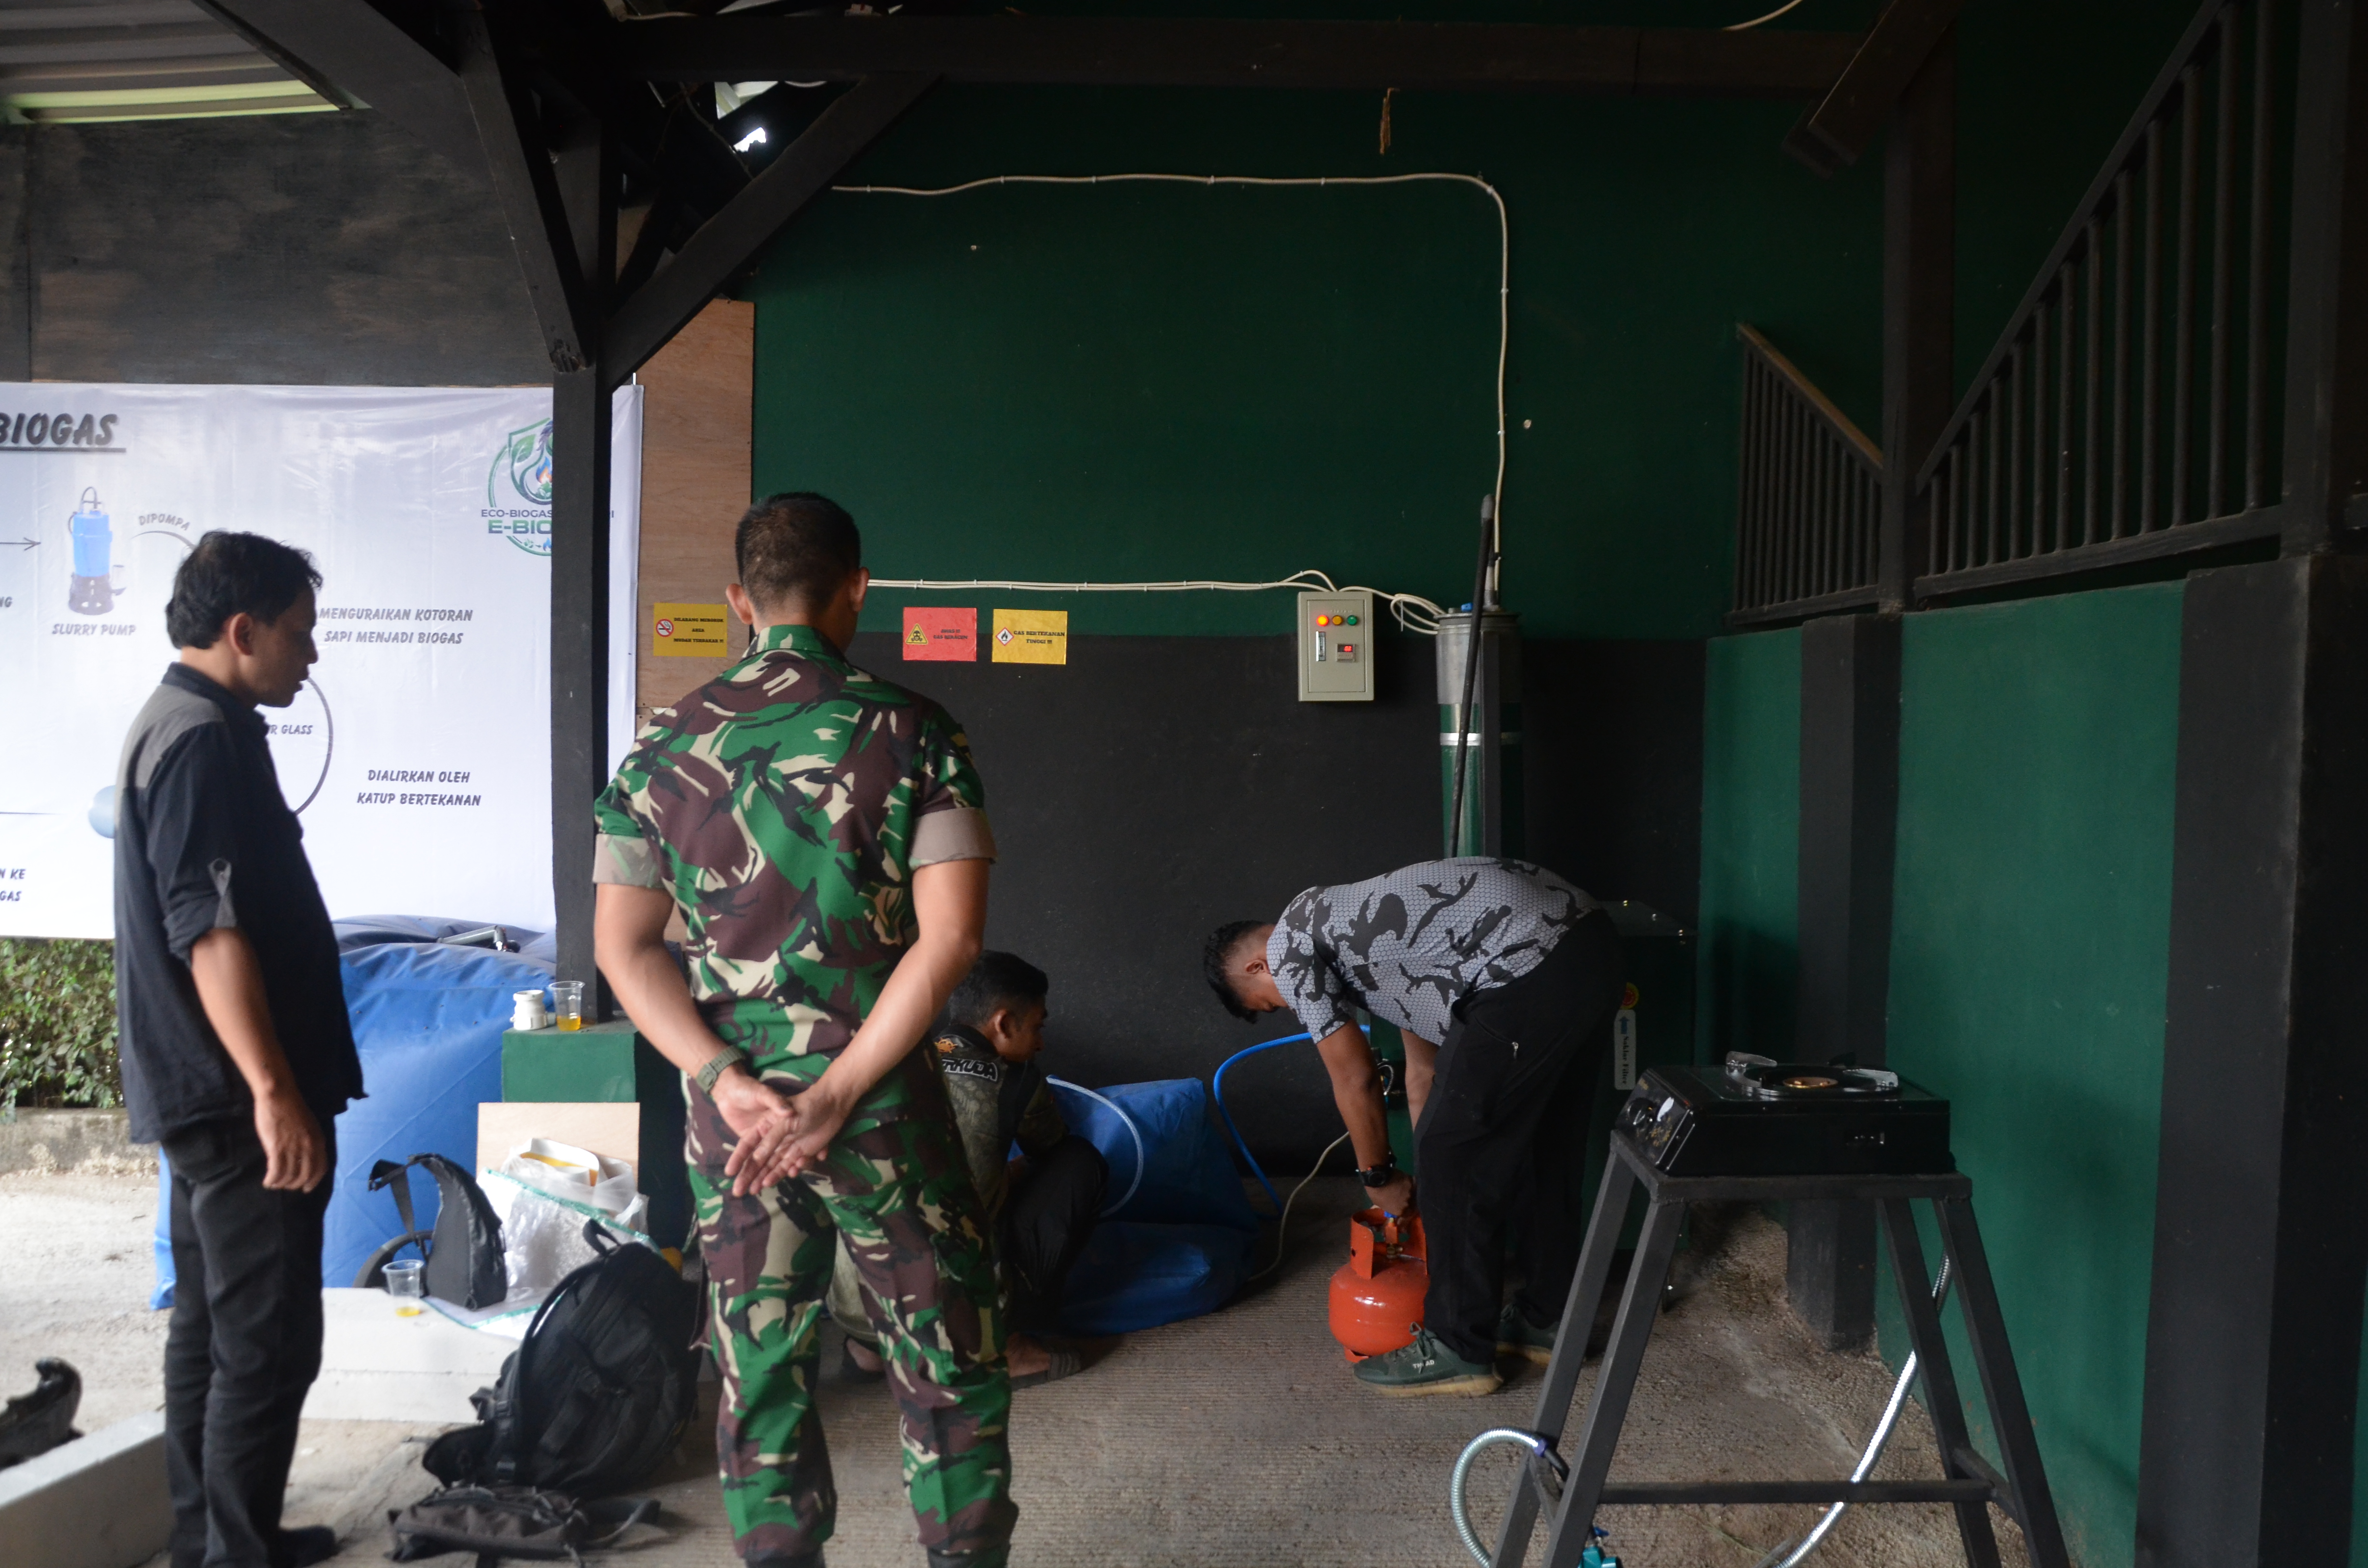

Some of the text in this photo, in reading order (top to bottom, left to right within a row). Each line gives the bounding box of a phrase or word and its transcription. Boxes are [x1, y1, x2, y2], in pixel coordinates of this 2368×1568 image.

[138, 513, 190, 530] DIPOMPA
[319, 607, 473, 622] MENGURAIKAN KOTORAN
[52, 624, 136, 636] SLURRY PUMP
[324, 631, 464, 644] SAPI MENJADI BIOGAS
[282, 724, 313, 735] GLASS
[368, 770, 470, 783] DIALIRKAN OLEH
[357, 792, 481, 806] KATUP BERTEKANAN
[11, 869, 26, 880] KE
